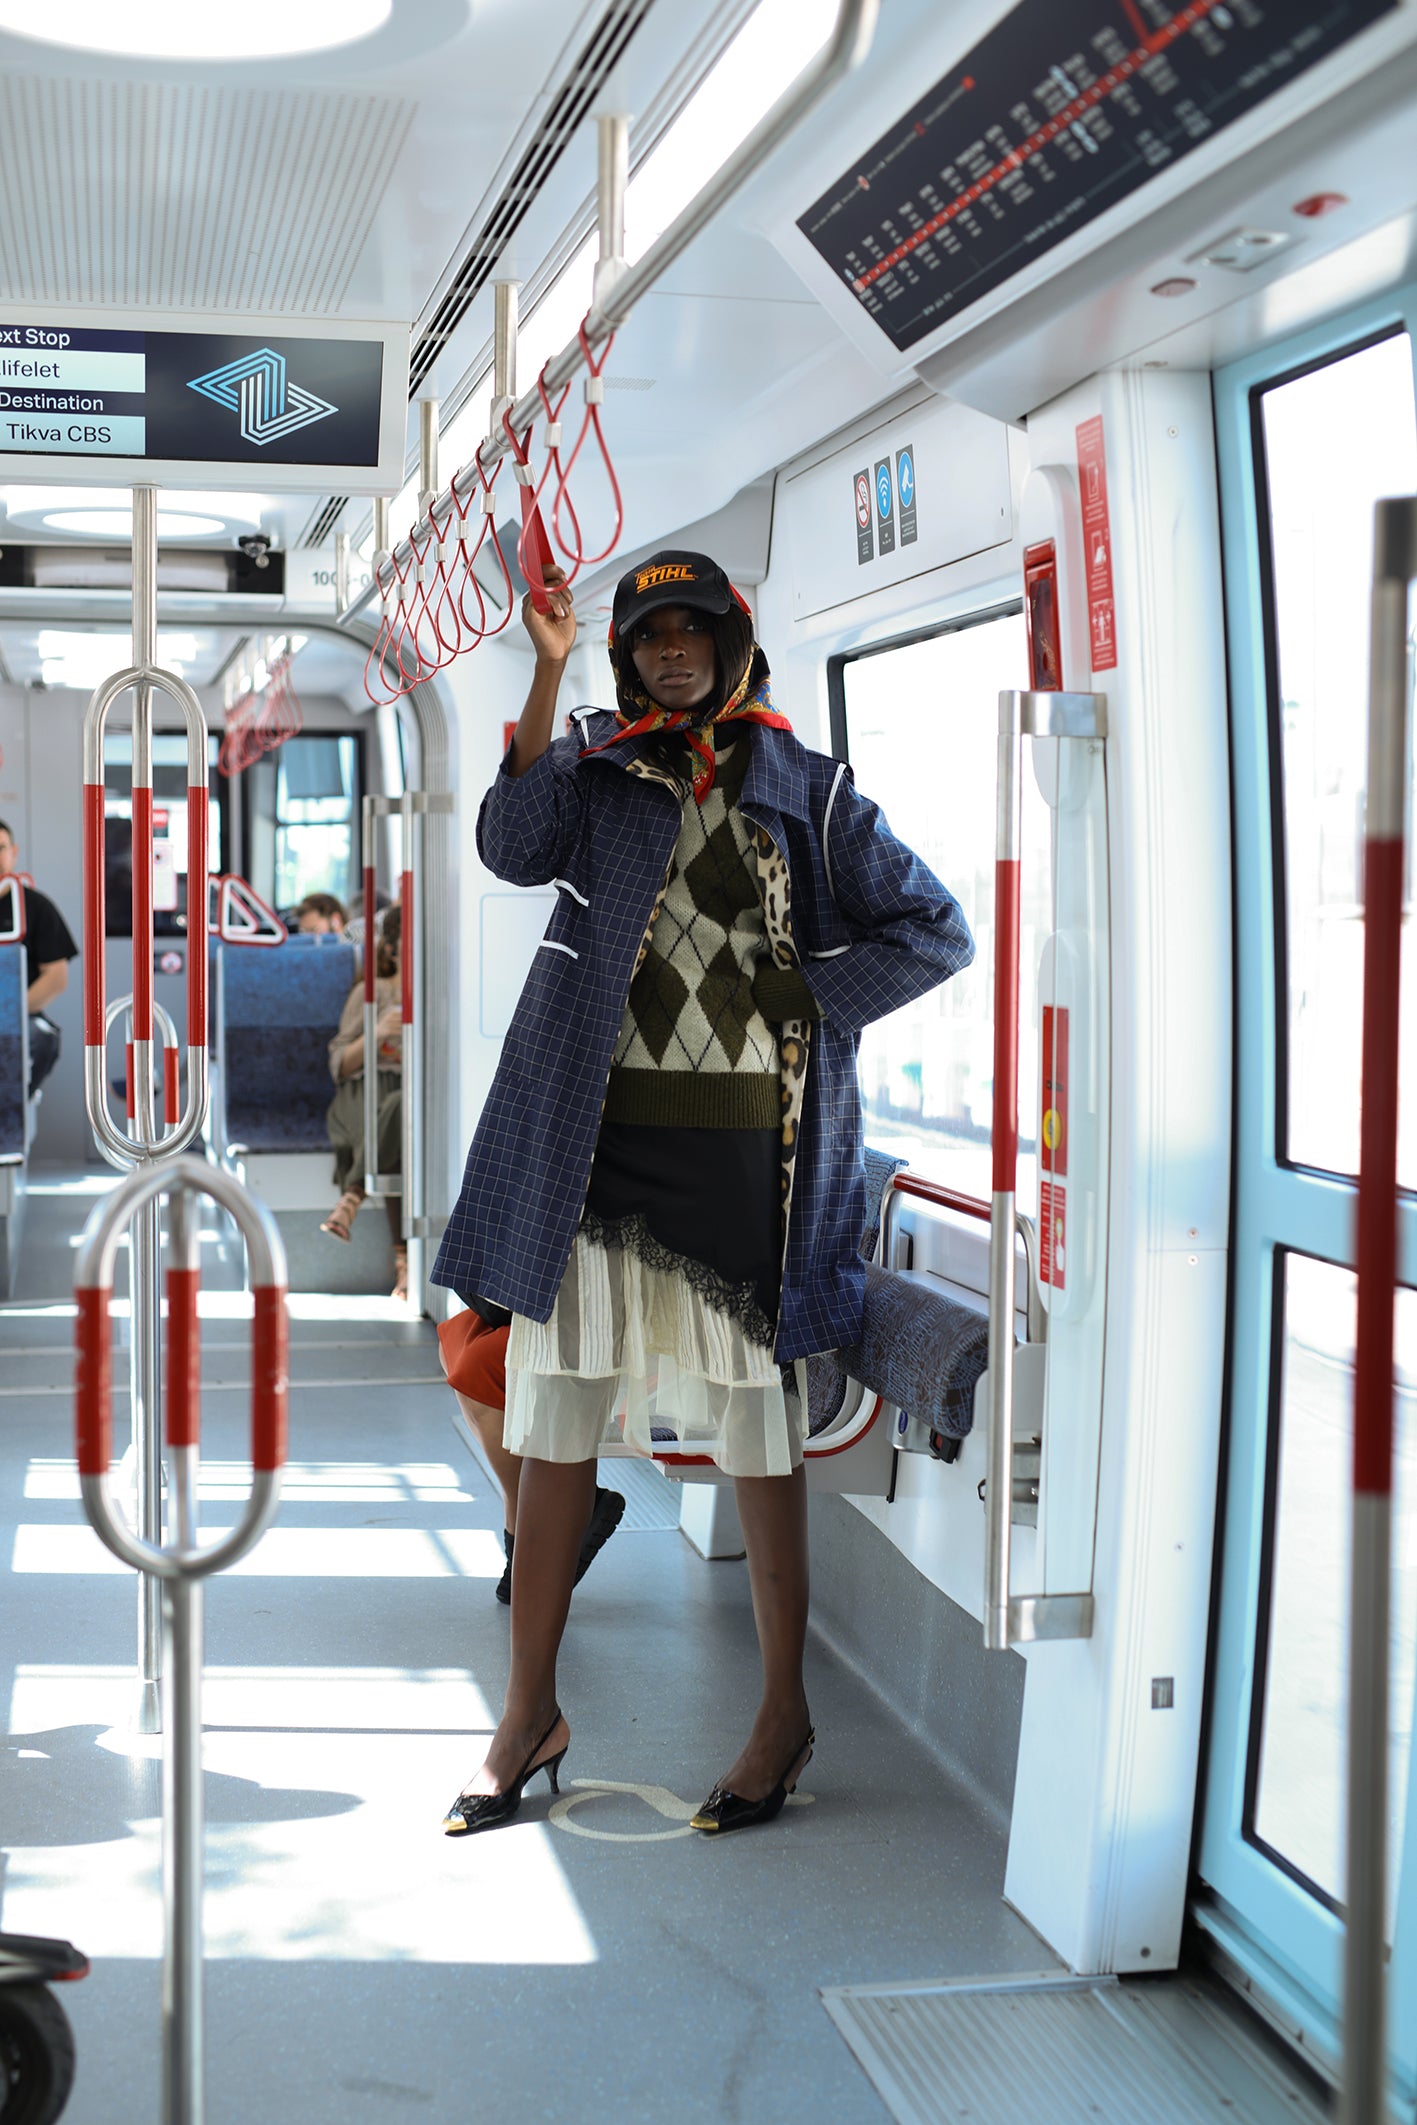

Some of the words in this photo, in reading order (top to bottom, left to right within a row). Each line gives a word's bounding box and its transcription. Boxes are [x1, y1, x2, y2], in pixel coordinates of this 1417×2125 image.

[0, 329, 21, 344] xt
[25, 328, 71, 349] Stop
[0, 359, 60, 378] lifelet
[0, 391, 104, 411] Destination
[6, 423, 61, 440] Tikva
[67, 425, 112, 443] CBS
[637, 567, 694, 590] STIHL
